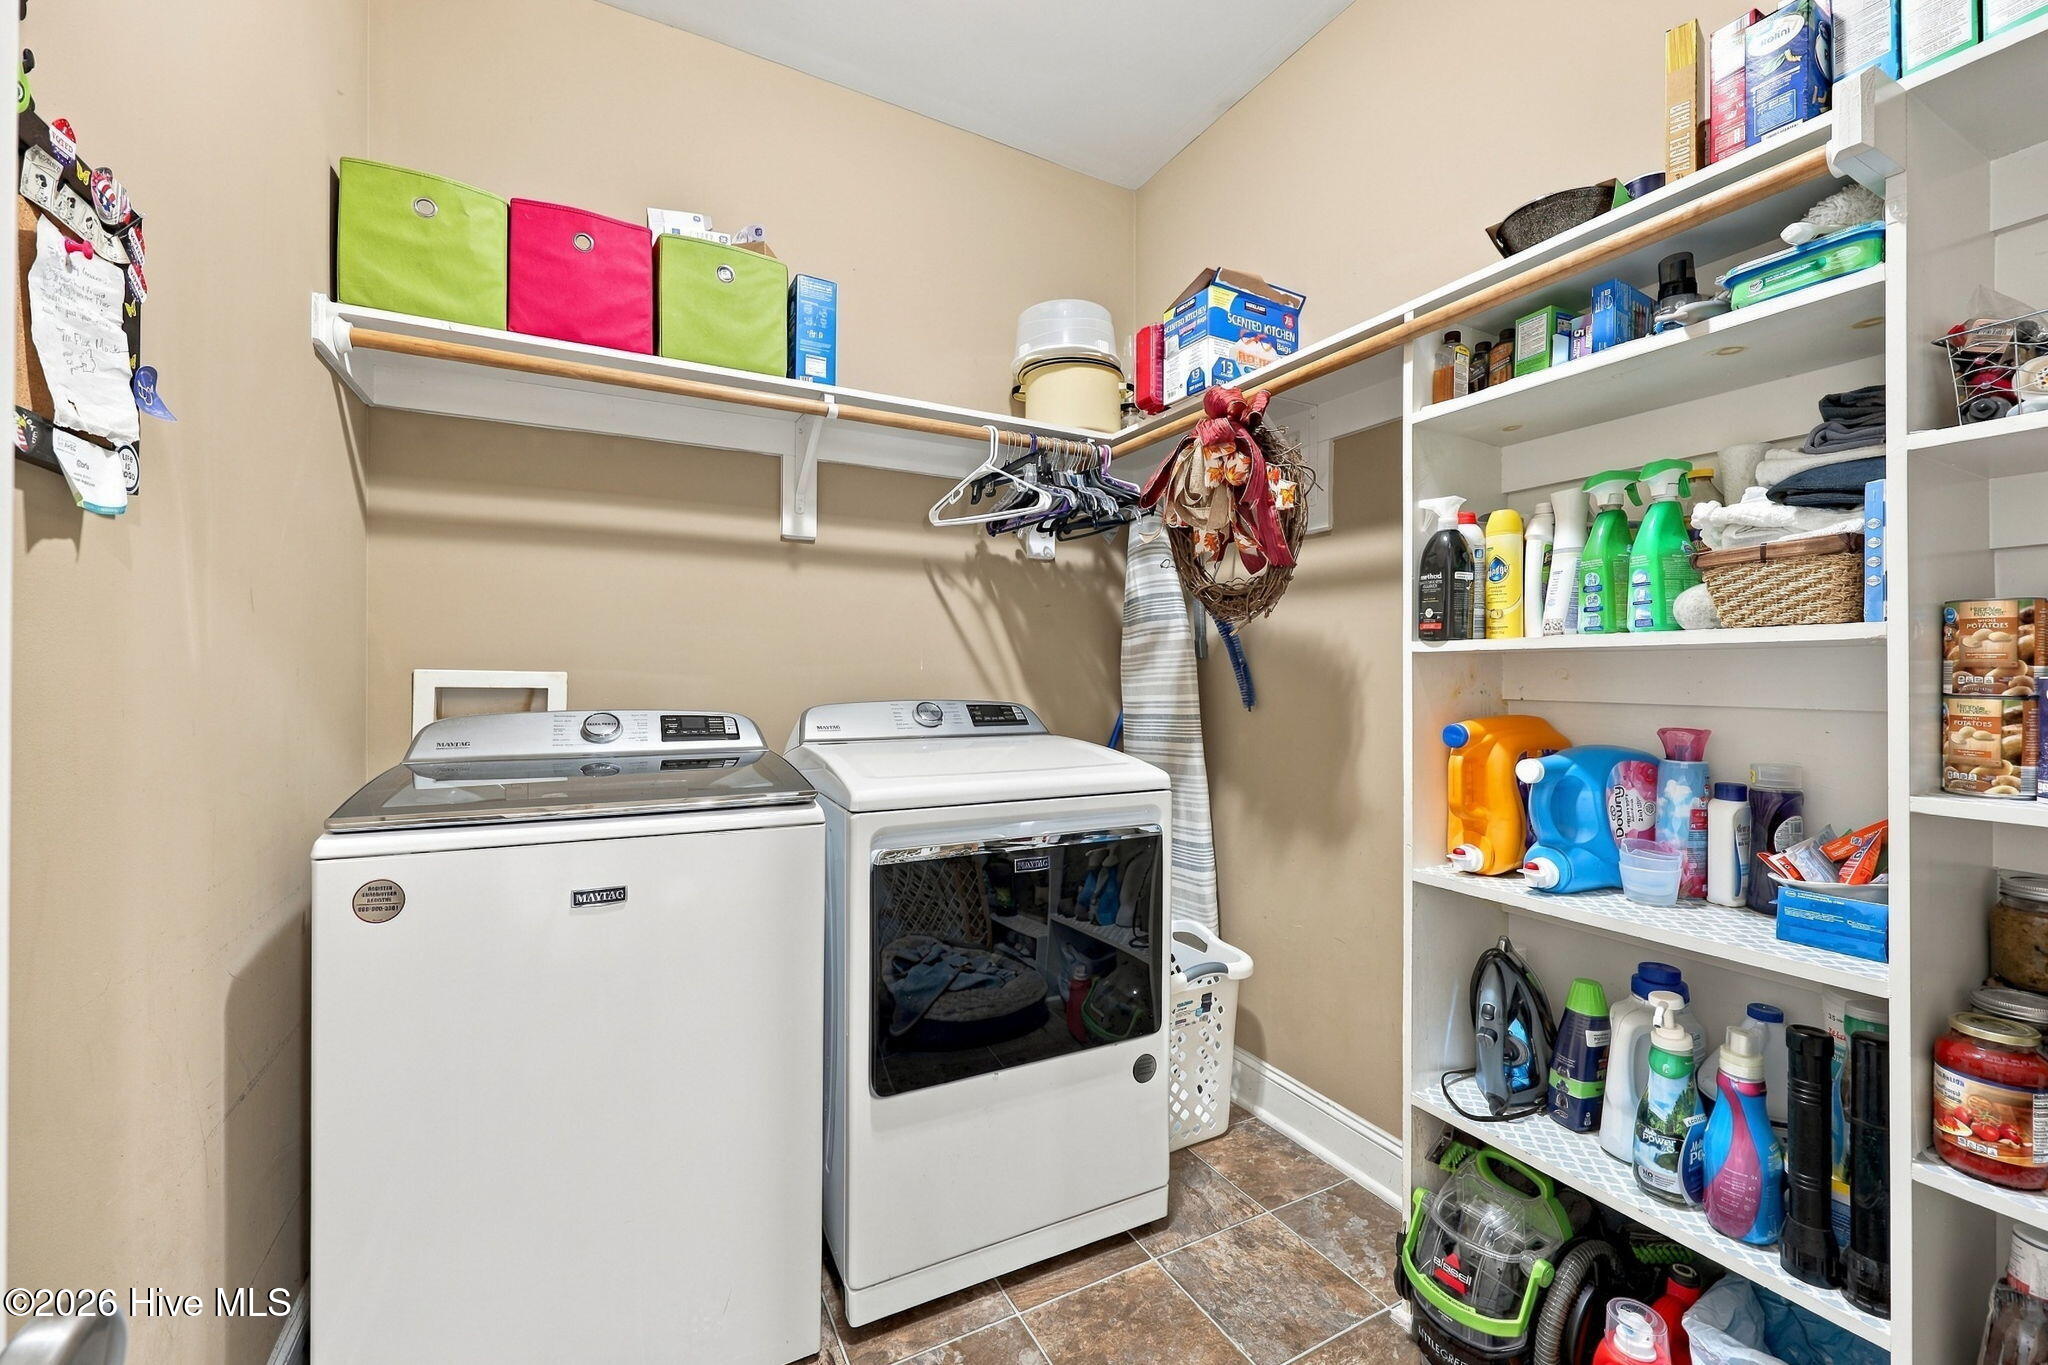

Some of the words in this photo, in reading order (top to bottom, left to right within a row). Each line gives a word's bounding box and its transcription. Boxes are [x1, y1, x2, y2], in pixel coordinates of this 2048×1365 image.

[1669, 100, 1691, 134] HAIR
[51, 130, 74, 154] VOTED
[1669, 131, 1691, 174] ANGEL
[1227, 313, 1262, 333] SCENTED
[1264, 324, 1296, 343] KITCHEN
[1220, 360, 1234, 374] 13
[1420, 571, 1443, 580] method
[1953, 720, 1993, 728] POTATOES
[1614, 786, 1625, 839] Downy
[575, 889, 625, 904] MAYTAG
